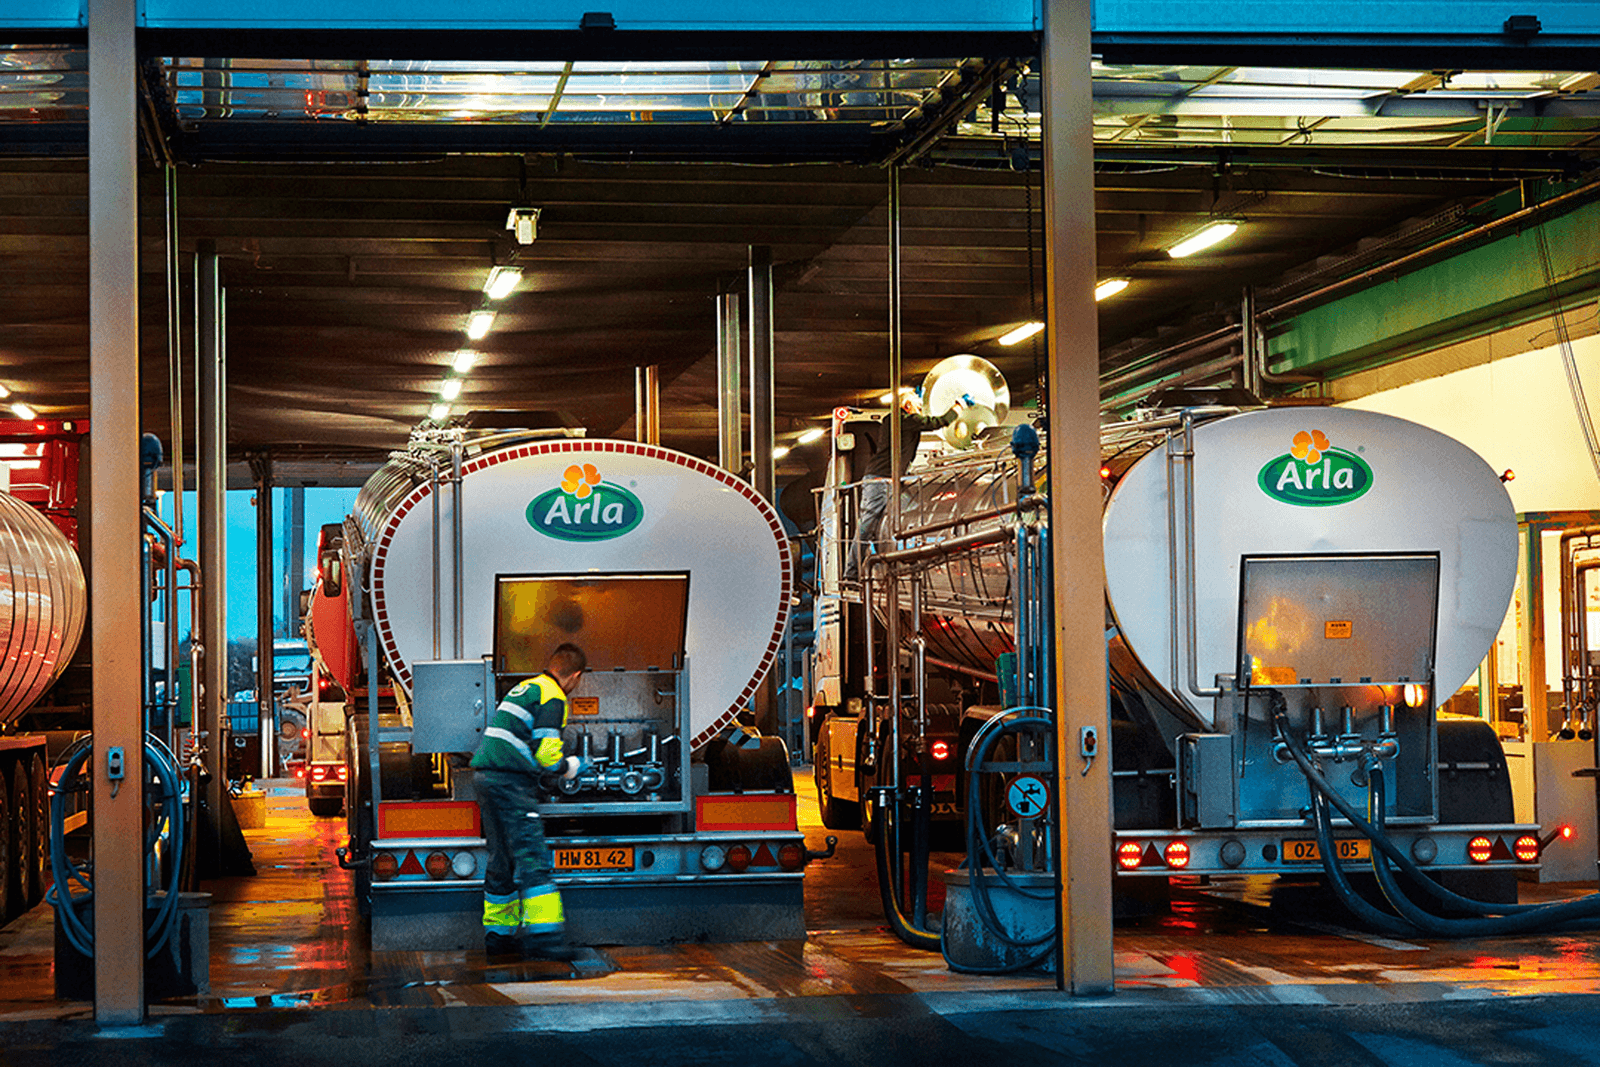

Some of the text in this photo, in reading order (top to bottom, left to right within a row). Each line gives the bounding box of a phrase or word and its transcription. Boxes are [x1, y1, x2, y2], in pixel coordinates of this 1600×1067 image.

[1276, 458, 1354, 491] Arla
[544, 493, 624, 525] Arla
[559, 850, 626, 866] HW 81 42
[1294, 841, 1359, 858] OZ 05
